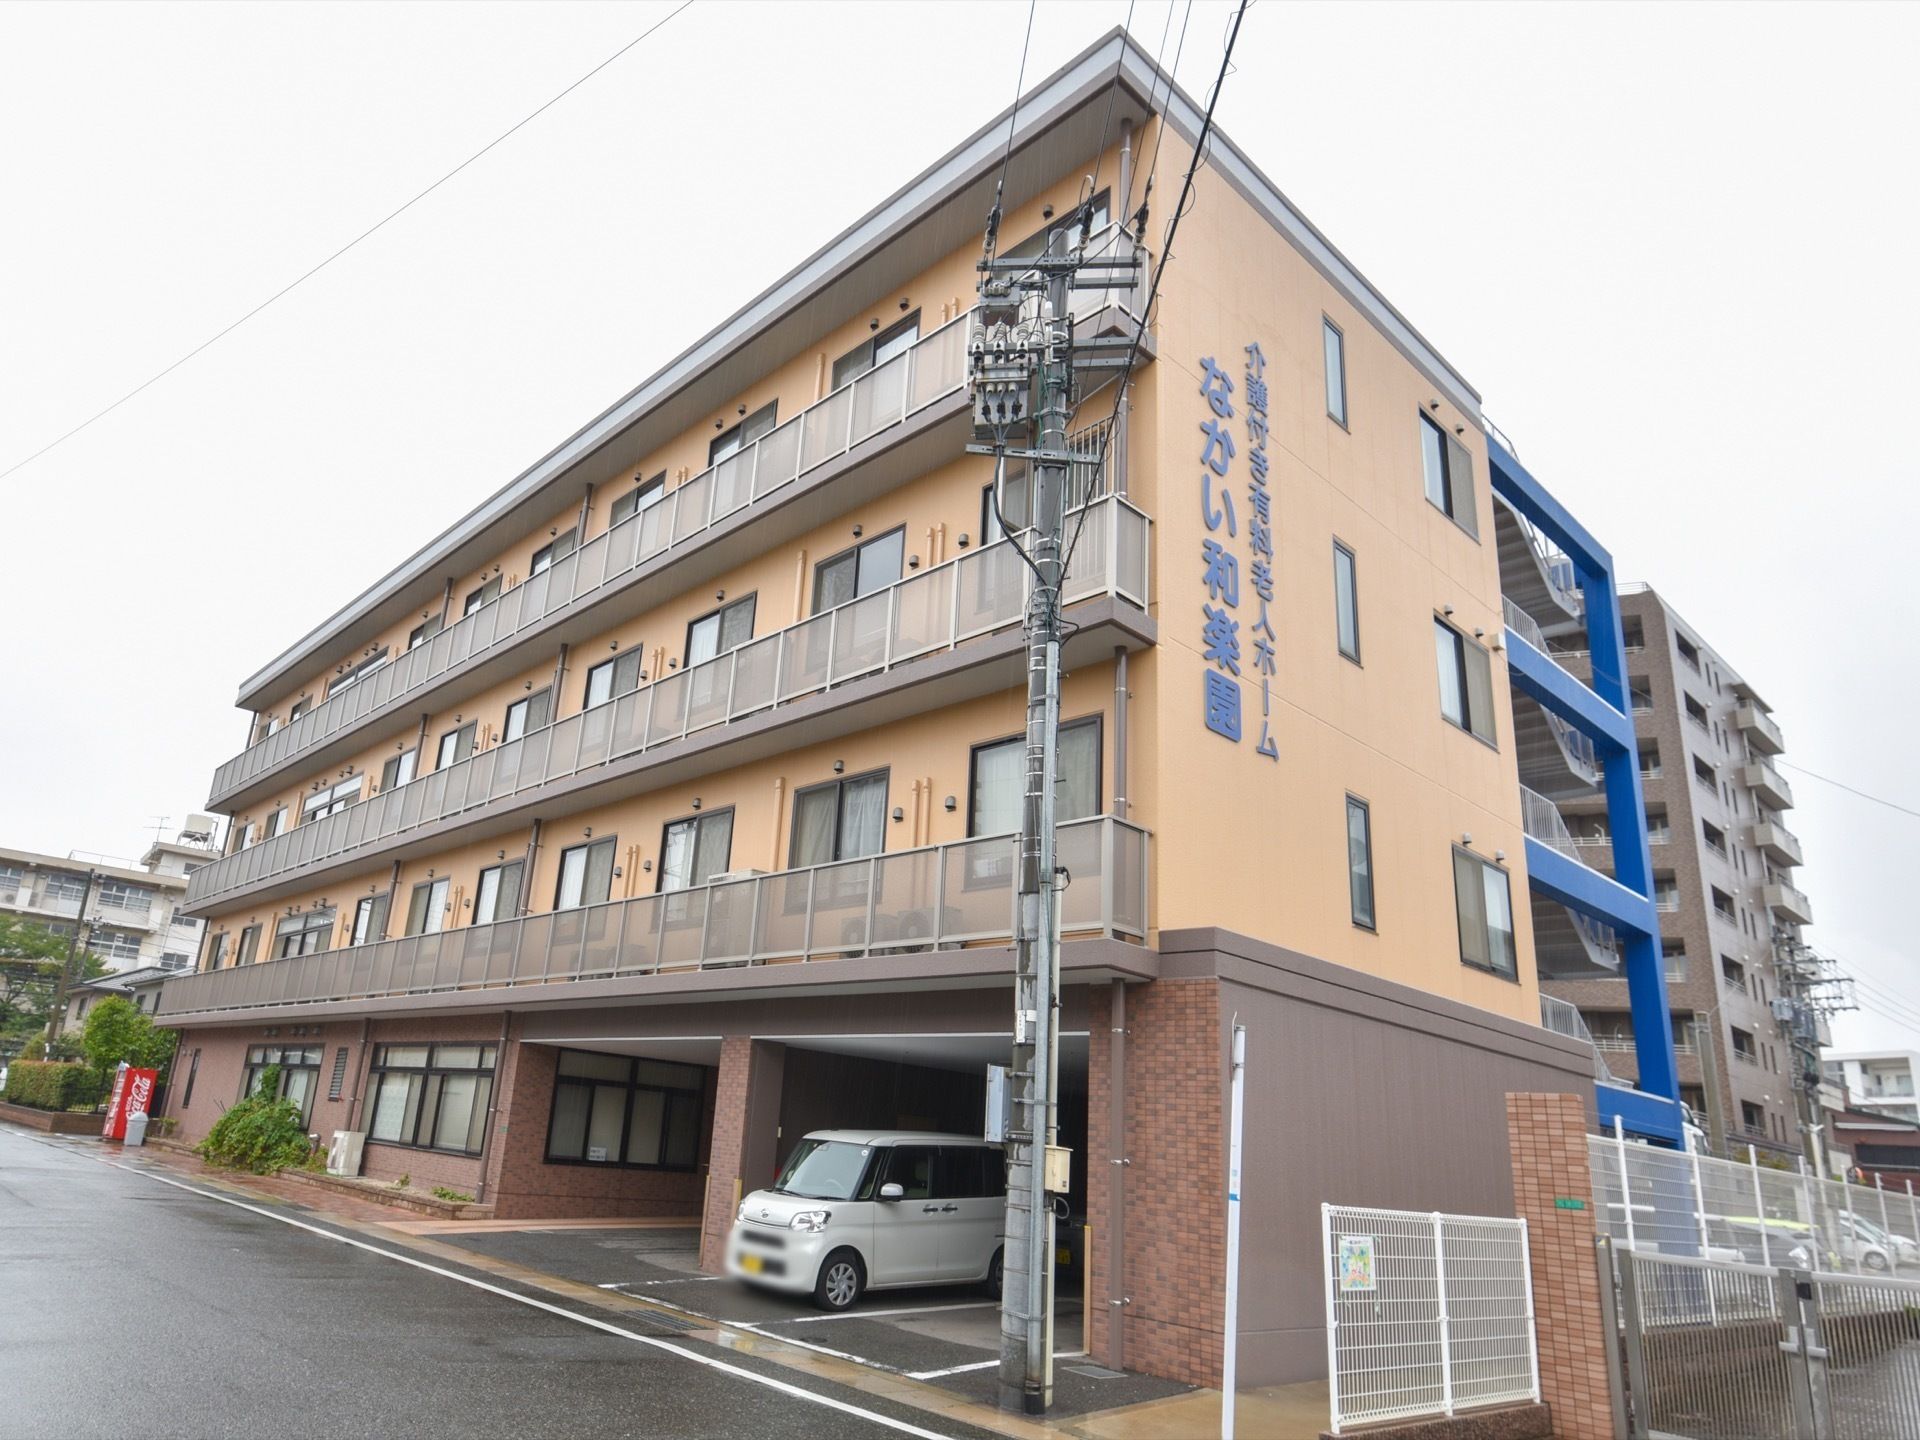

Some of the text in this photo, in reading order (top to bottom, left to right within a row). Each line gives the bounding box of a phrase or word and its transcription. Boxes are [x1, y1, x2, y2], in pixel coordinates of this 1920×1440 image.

[1200, 356, 1242, 743] なかい和楽園
[1244, 341, 1279, 762] 介護付き有料老人ホーム
